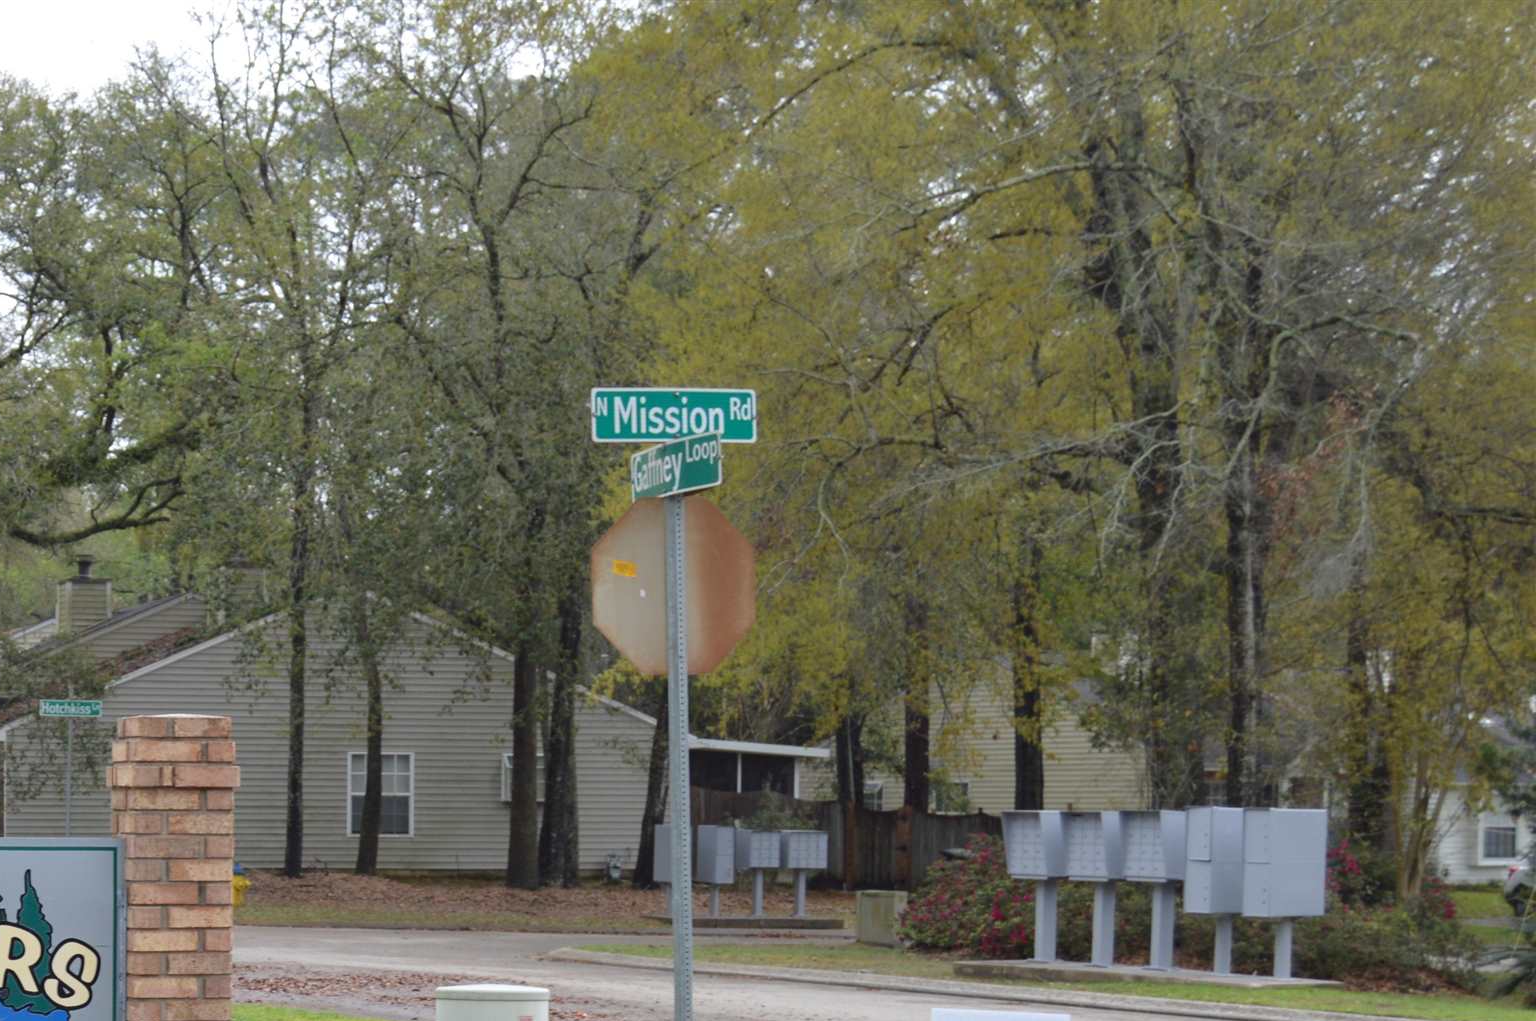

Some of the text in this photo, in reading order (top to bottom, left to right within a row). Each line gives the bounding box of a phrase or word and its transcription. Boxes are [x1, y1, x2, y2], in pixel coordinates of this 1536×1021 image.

[596, 397, 751, 434] N Mission Rd
[634, 437, 719, 492] Gaffney Loop
[41, 702, 91, 714] Hotchkiss
